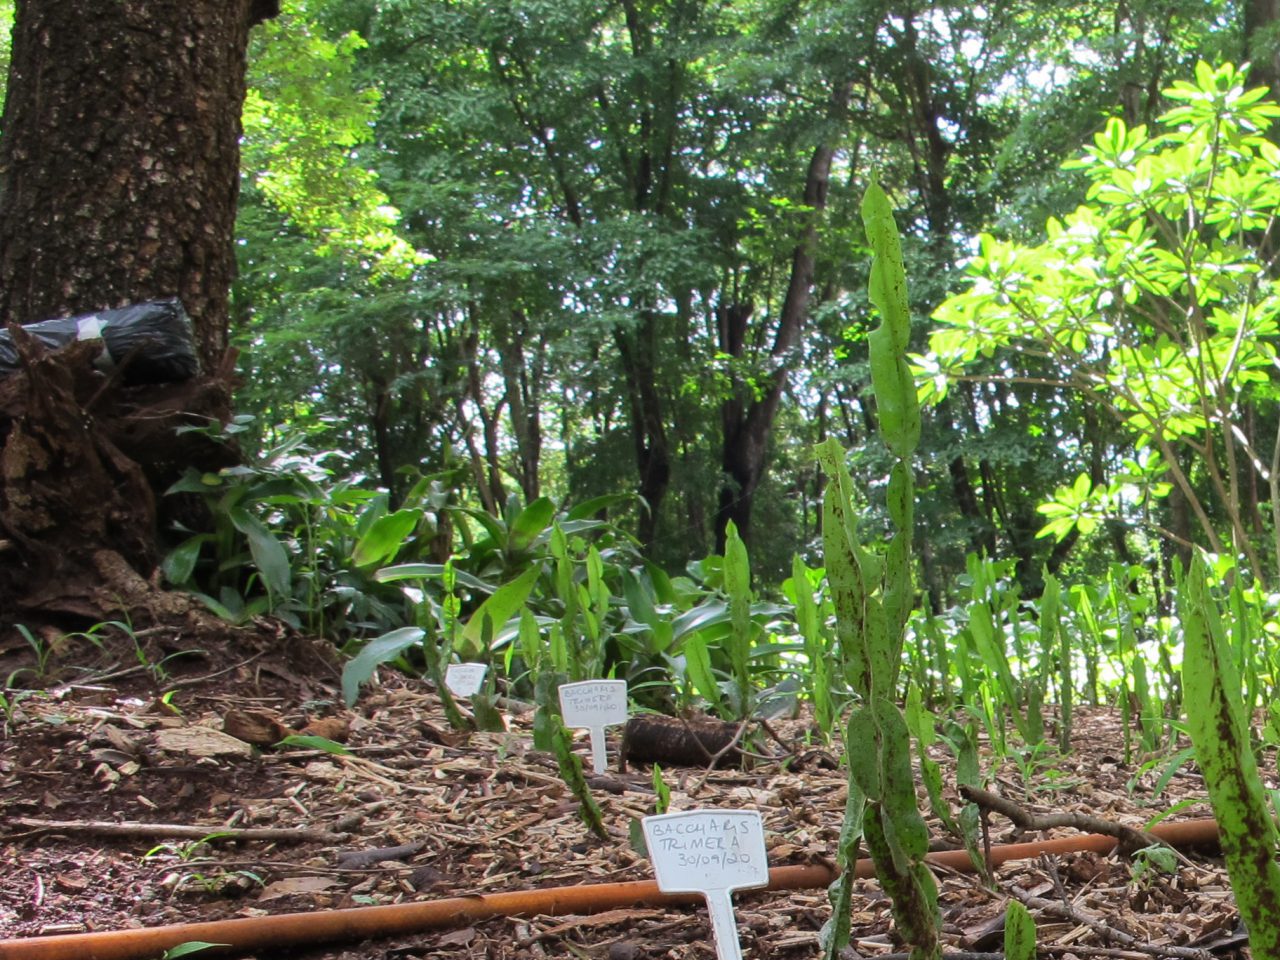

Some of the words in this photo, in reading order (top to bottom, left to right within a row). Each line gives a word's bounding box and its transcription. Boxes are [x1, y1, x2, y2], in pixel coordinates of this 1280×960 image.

[653, 819, 749, 836] BACCHARIS
[659, 836, 740, 851] TRIMERA
[678, 852, 751, 870] 30/09/20
